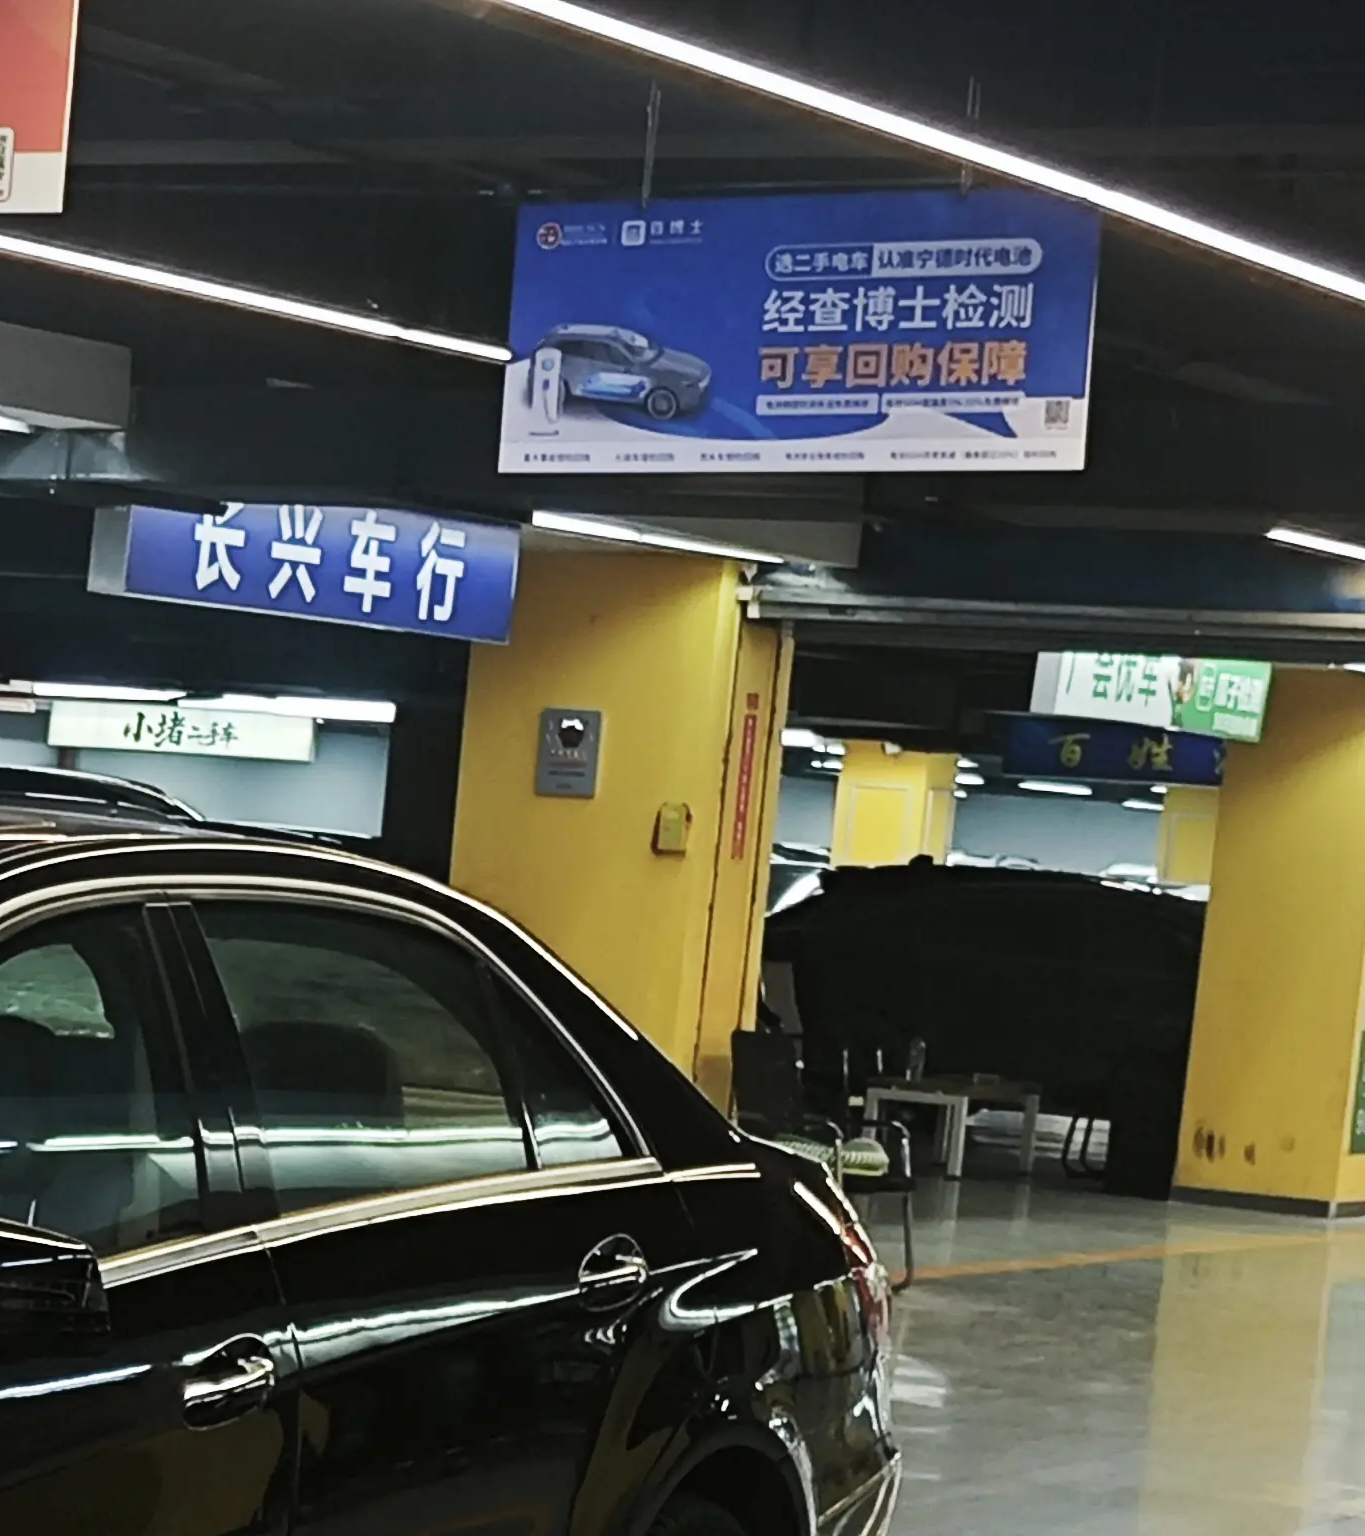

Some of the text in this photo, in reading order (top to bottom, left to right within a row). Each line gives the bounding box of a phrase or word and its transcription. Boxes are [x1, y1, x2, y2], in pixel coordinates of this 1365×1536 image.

[762, 281, 1036, 335] 经查博士检测
[757, 339, 1030, 390] 可享回购保障
[194, 502, 466, 622] 长兴车行
